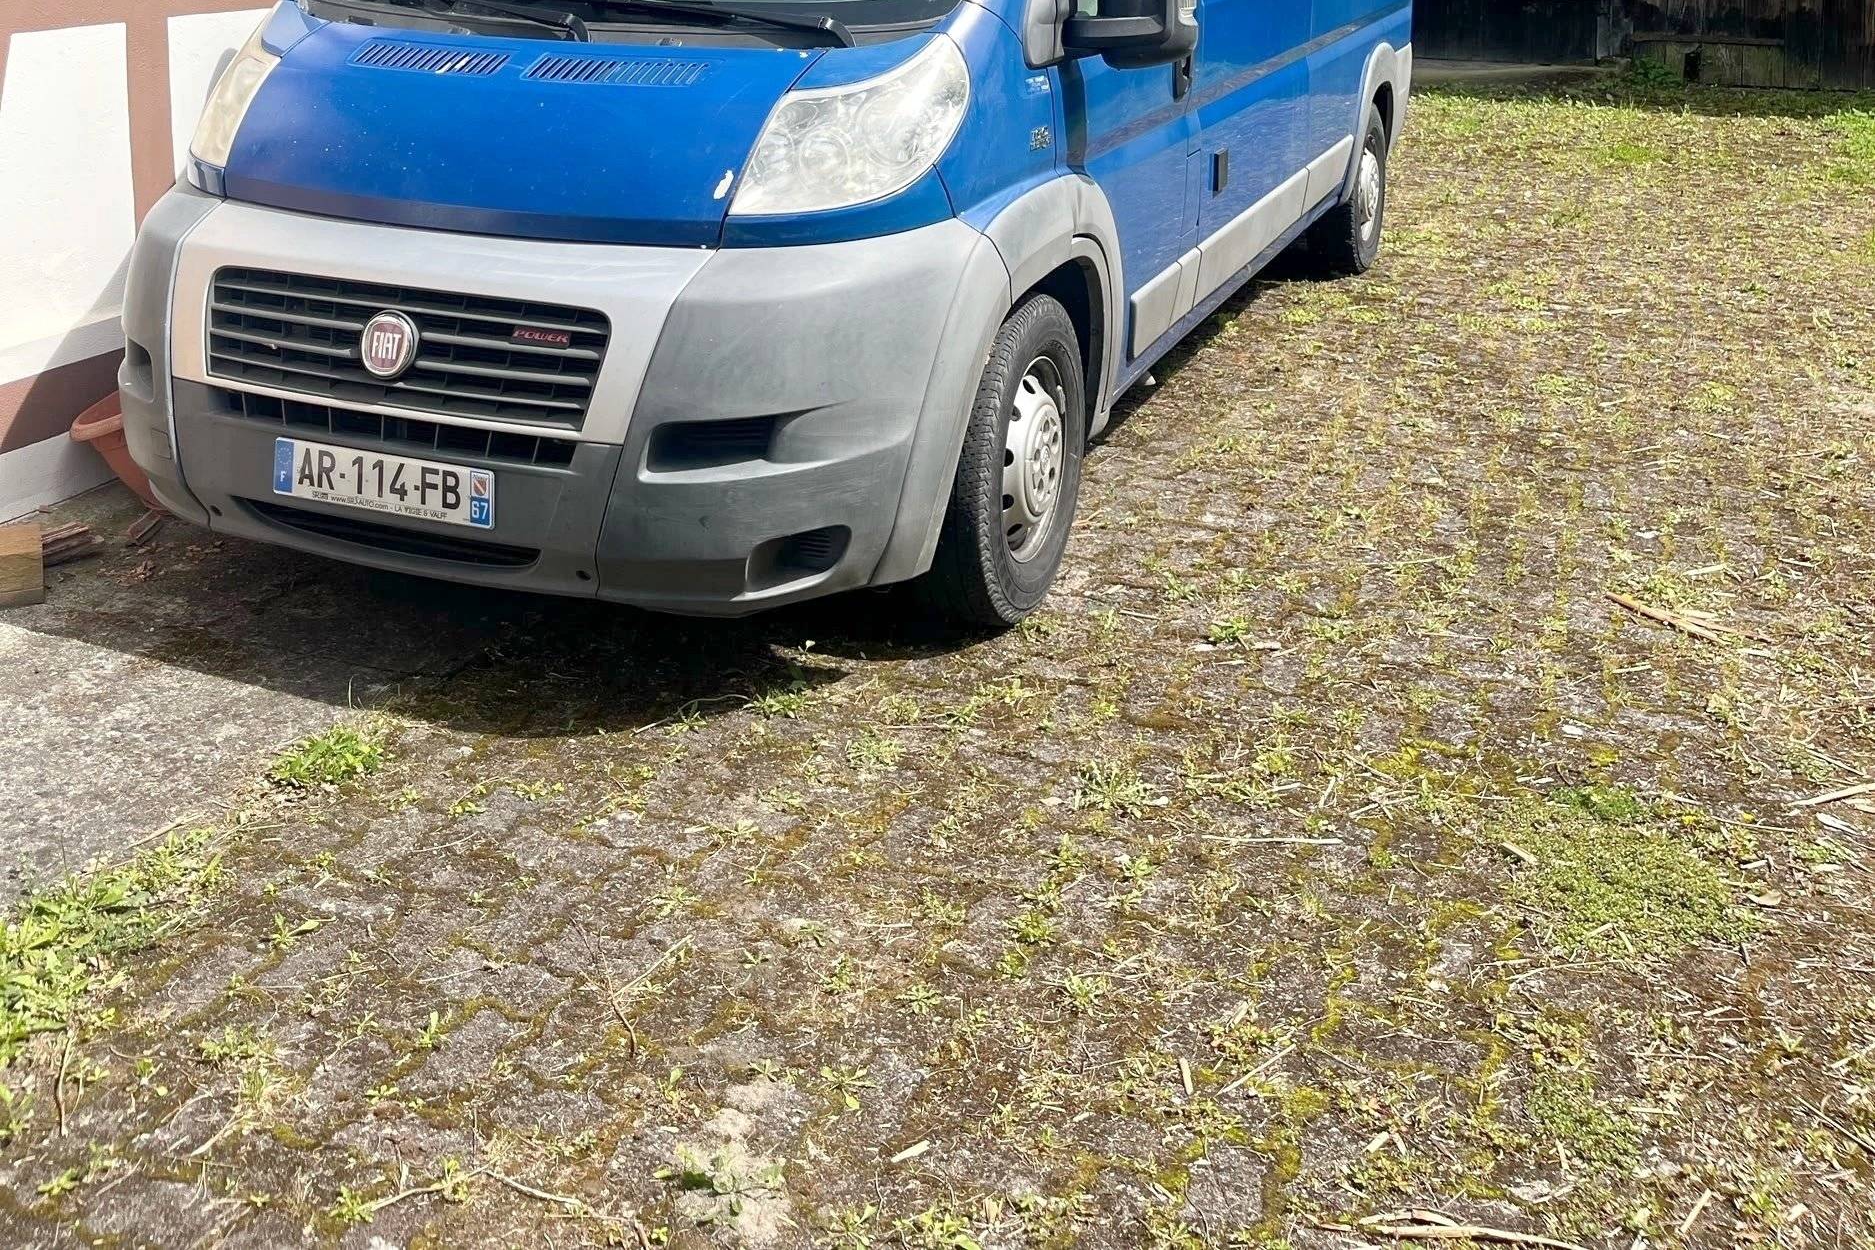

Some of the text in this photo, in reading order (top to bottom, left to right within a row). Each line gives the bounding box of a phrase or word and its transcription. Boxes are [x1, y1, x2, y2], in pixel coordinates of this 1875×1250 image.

[372, 330, 401, 359] FIAT
[512, 329, 570, 344] POWER
[280, 470, 286, 483] F
[297, 446, 462, 511] AR-114-FB
[471, 500, 489, 520] 67
